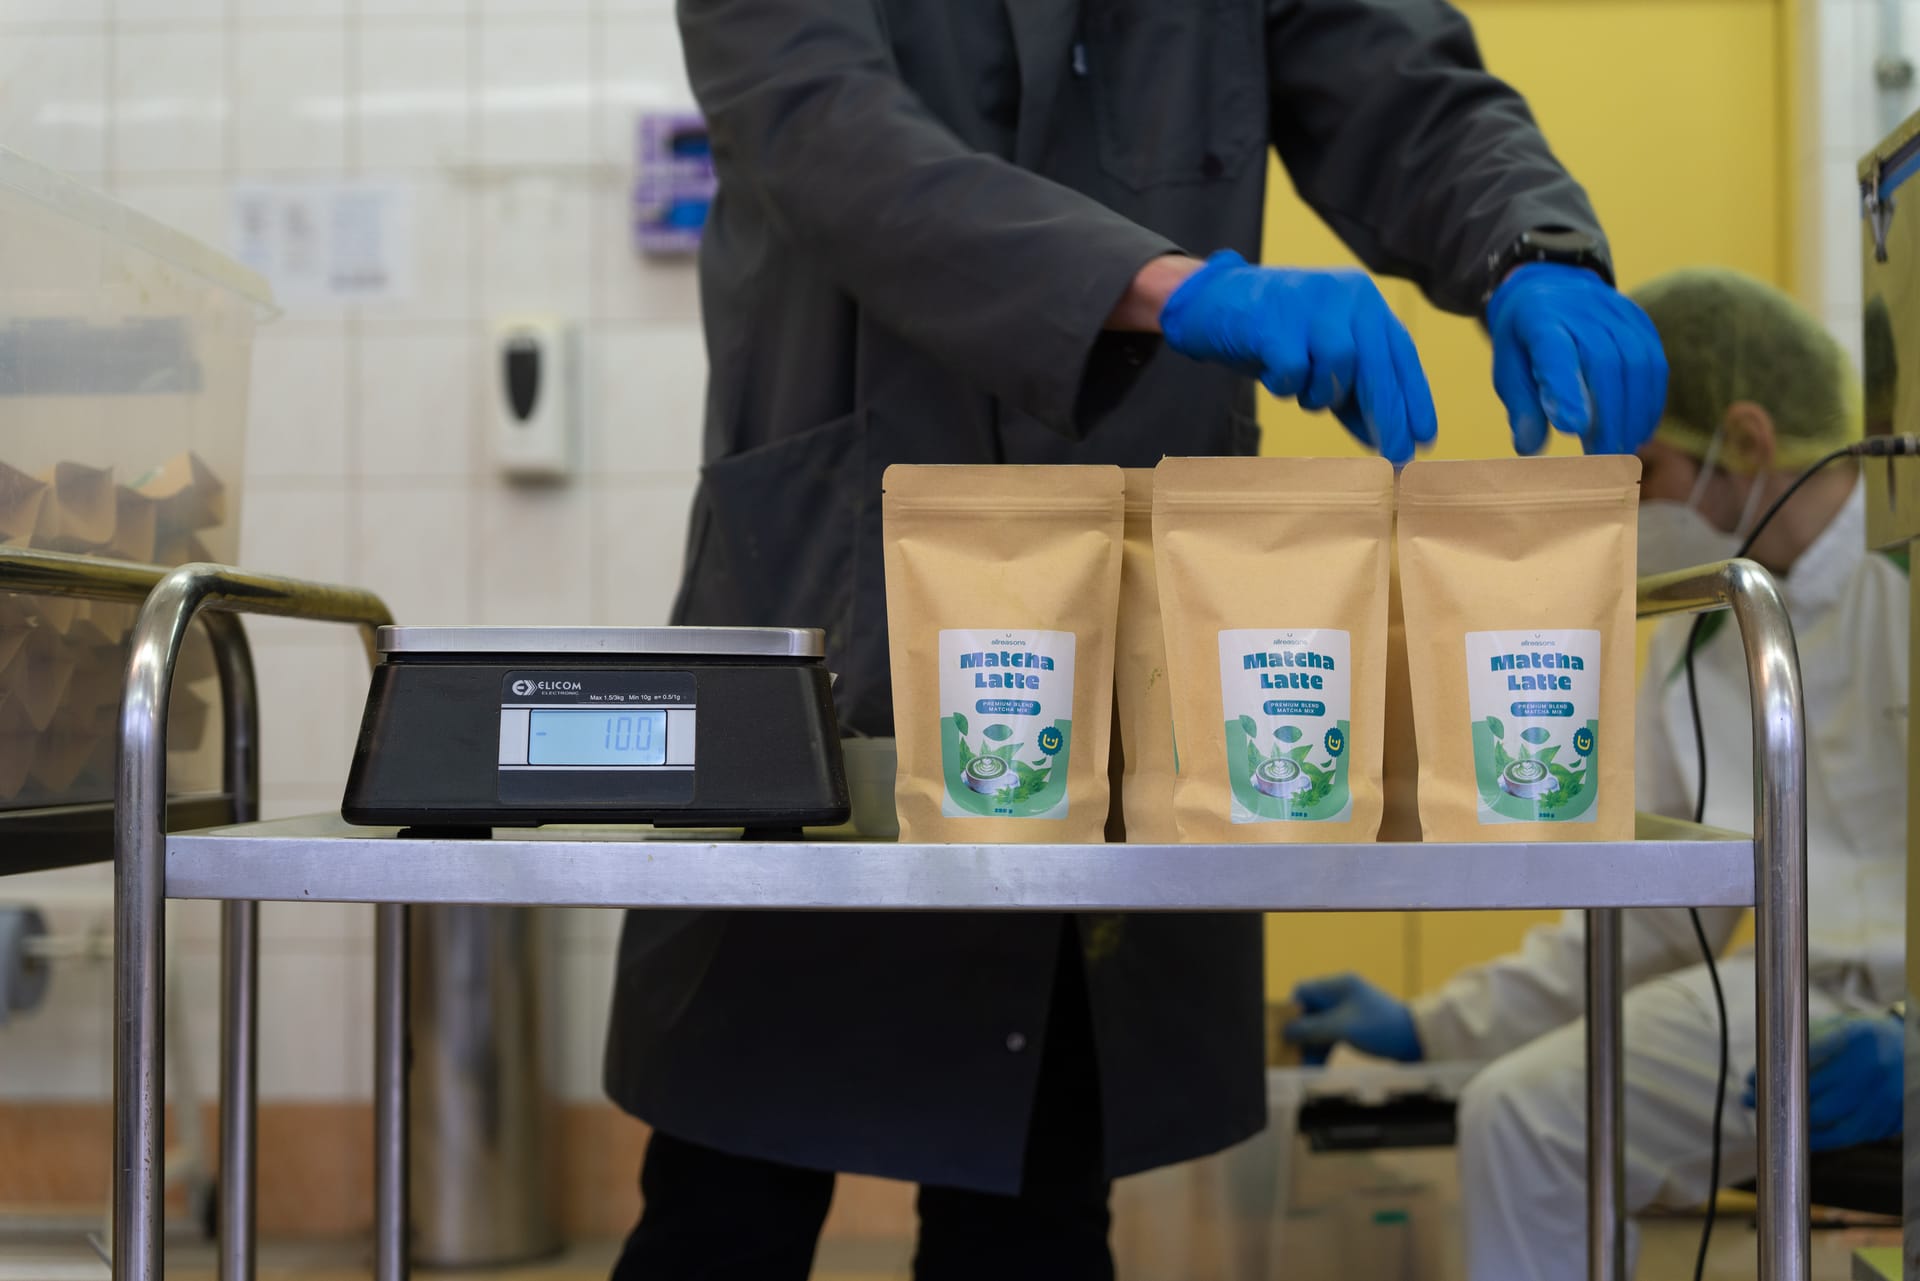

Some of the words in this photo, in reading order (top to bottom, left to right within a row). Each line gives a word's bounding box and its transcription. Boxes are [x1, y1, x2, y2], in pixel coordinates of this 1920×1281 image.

[960, 651, 1055, 671] Matcha
[1243, 651, 1335, 671] Matcha
[1490, 652, 1584, 672] Matcha
[537, 681, 582, 691] ELICOM
[975, 672, 1040, 690] Latte
[1260, 672, 1324, 690] Latte
[1507, 673, 1572, 691] Latte
